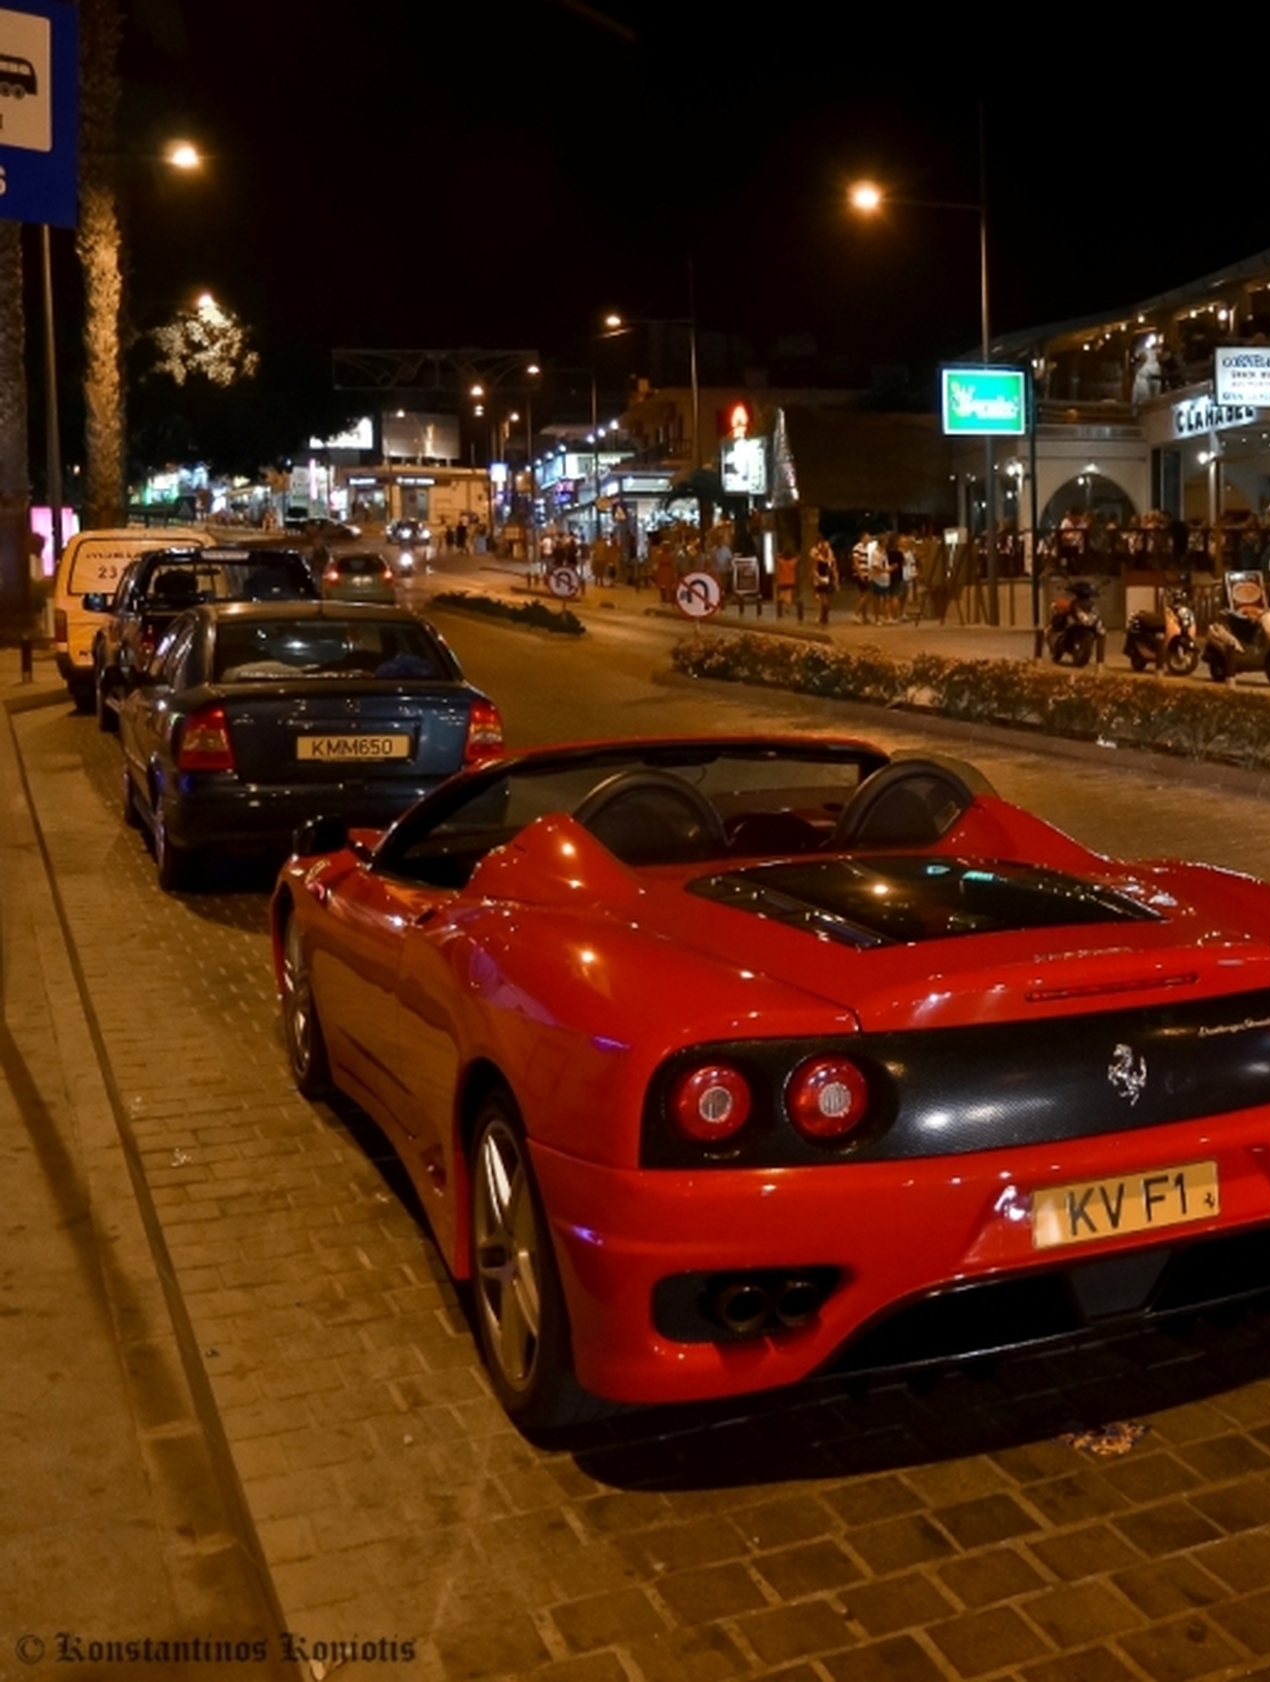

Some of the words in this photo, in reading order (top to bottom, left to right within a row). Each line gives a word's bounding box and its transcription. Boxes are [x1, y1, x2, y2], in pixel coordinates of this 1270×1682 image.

[311, 738, 394, 757] KMM650
[1066, 1182, 1125, 1237] KV
[1142, 1172, 1187, 1223] F1
